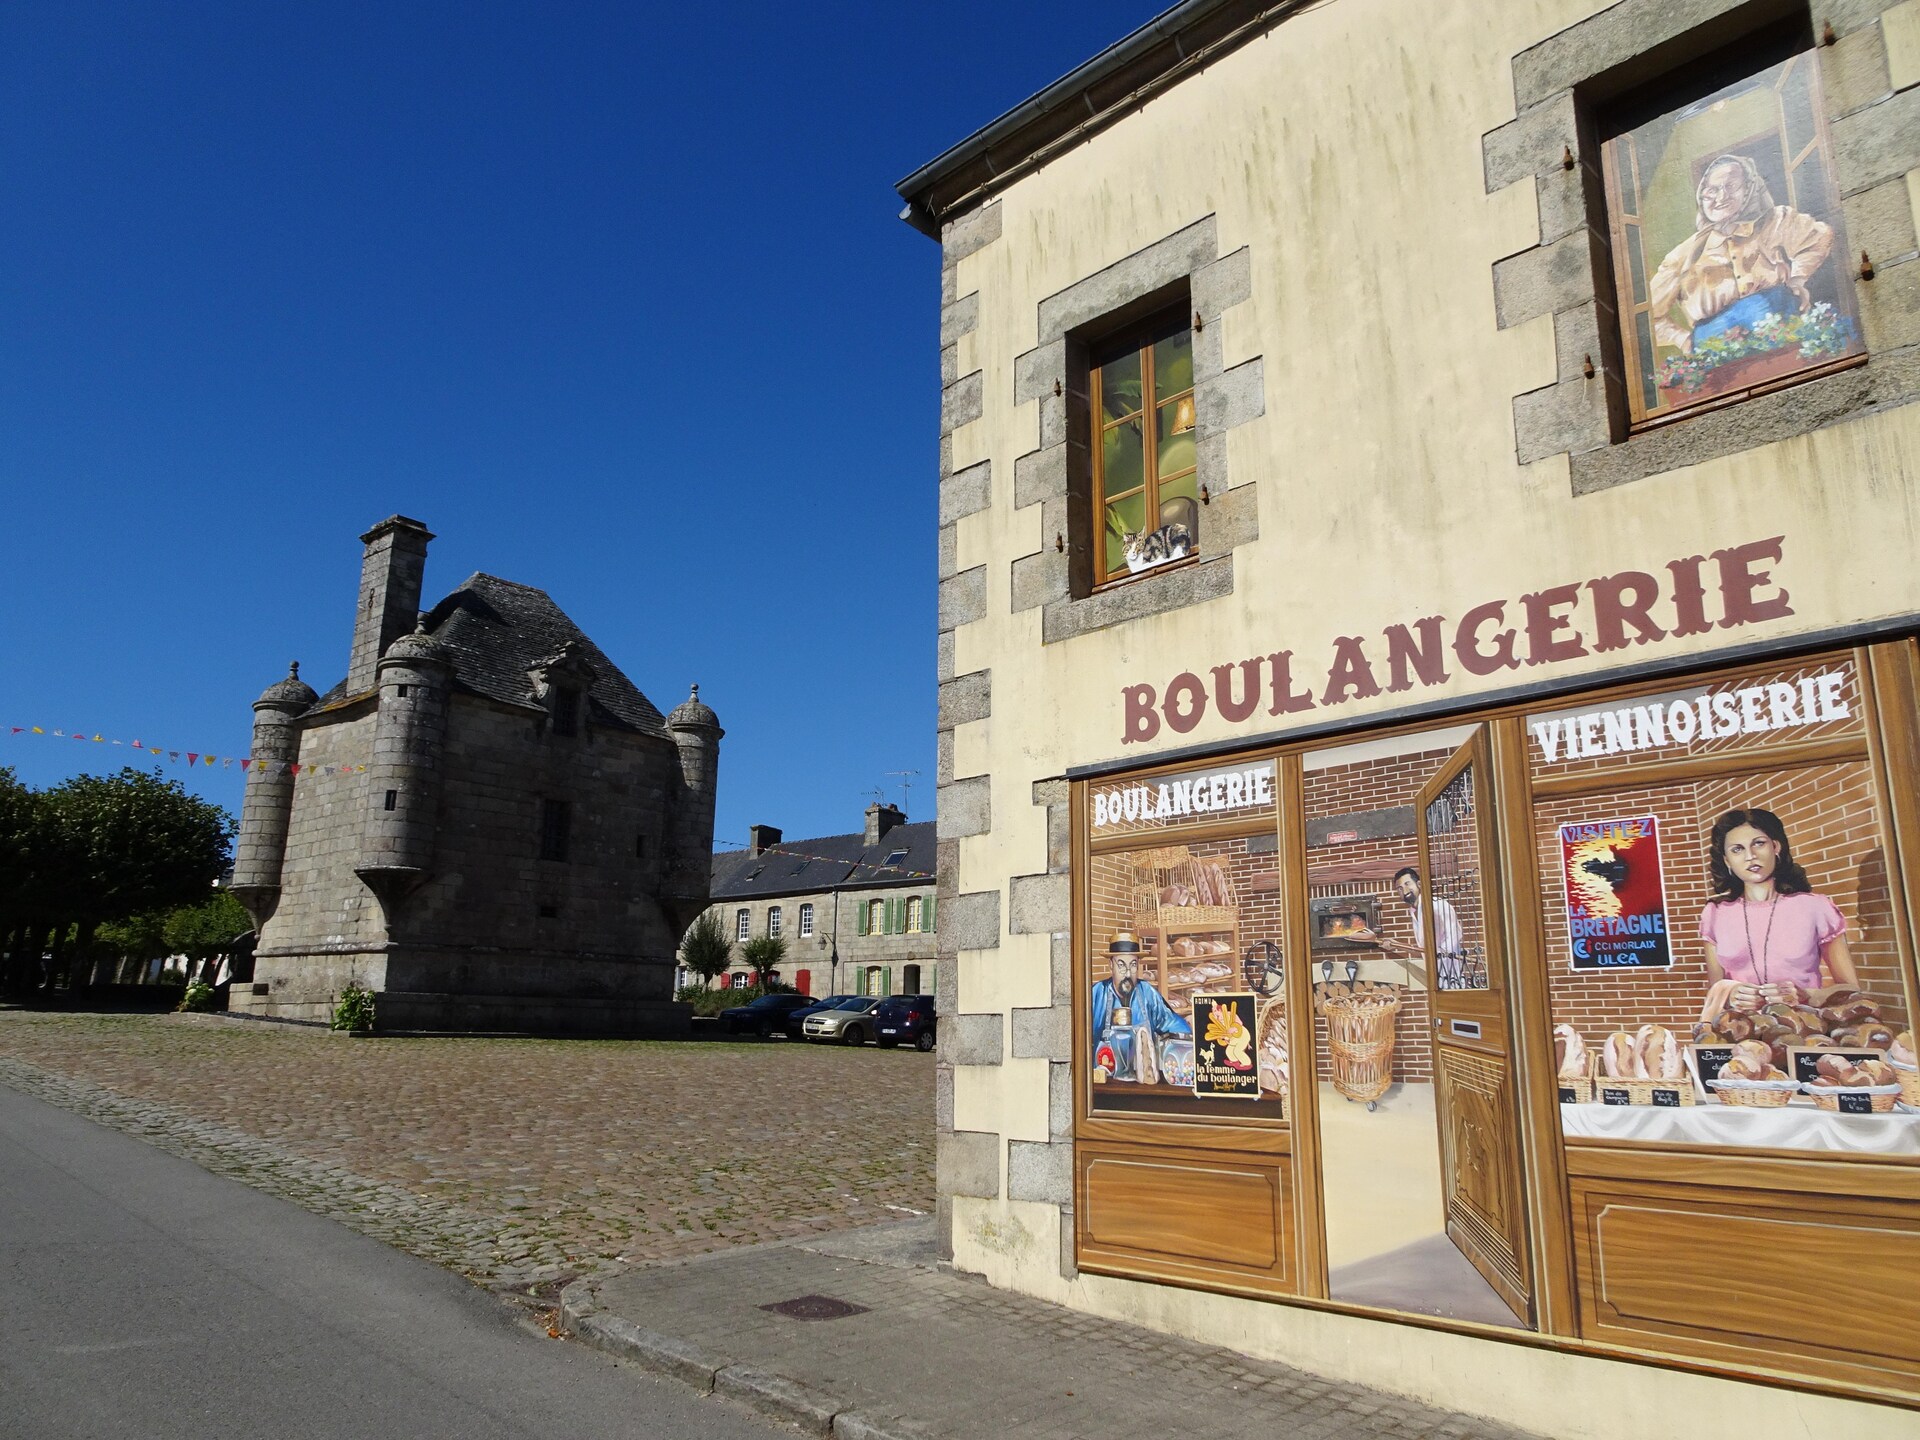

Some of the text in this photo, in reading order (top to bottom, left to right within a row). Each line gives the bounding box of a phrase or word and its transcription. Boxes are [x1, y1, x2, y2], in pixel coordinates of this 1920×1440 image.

[1121, 535, 1795, 745] BOULANGERIE
[1532, 671, 1852, 763] VIENNOISERIE
[1094, 766, 1272, 826] BOULANGERIE
[1561, 819, 1652, 843] VISITEZ
[1569, 905, 1587, 917] LA
[1570, 914, 1664, 938] BRETAGNE
[1594, 939, 1656, 951] CCI MORLAIX
[1196, 1063, 1236, 1074] la femme
[1197, 1073, 1257, 1086] du boulanger
